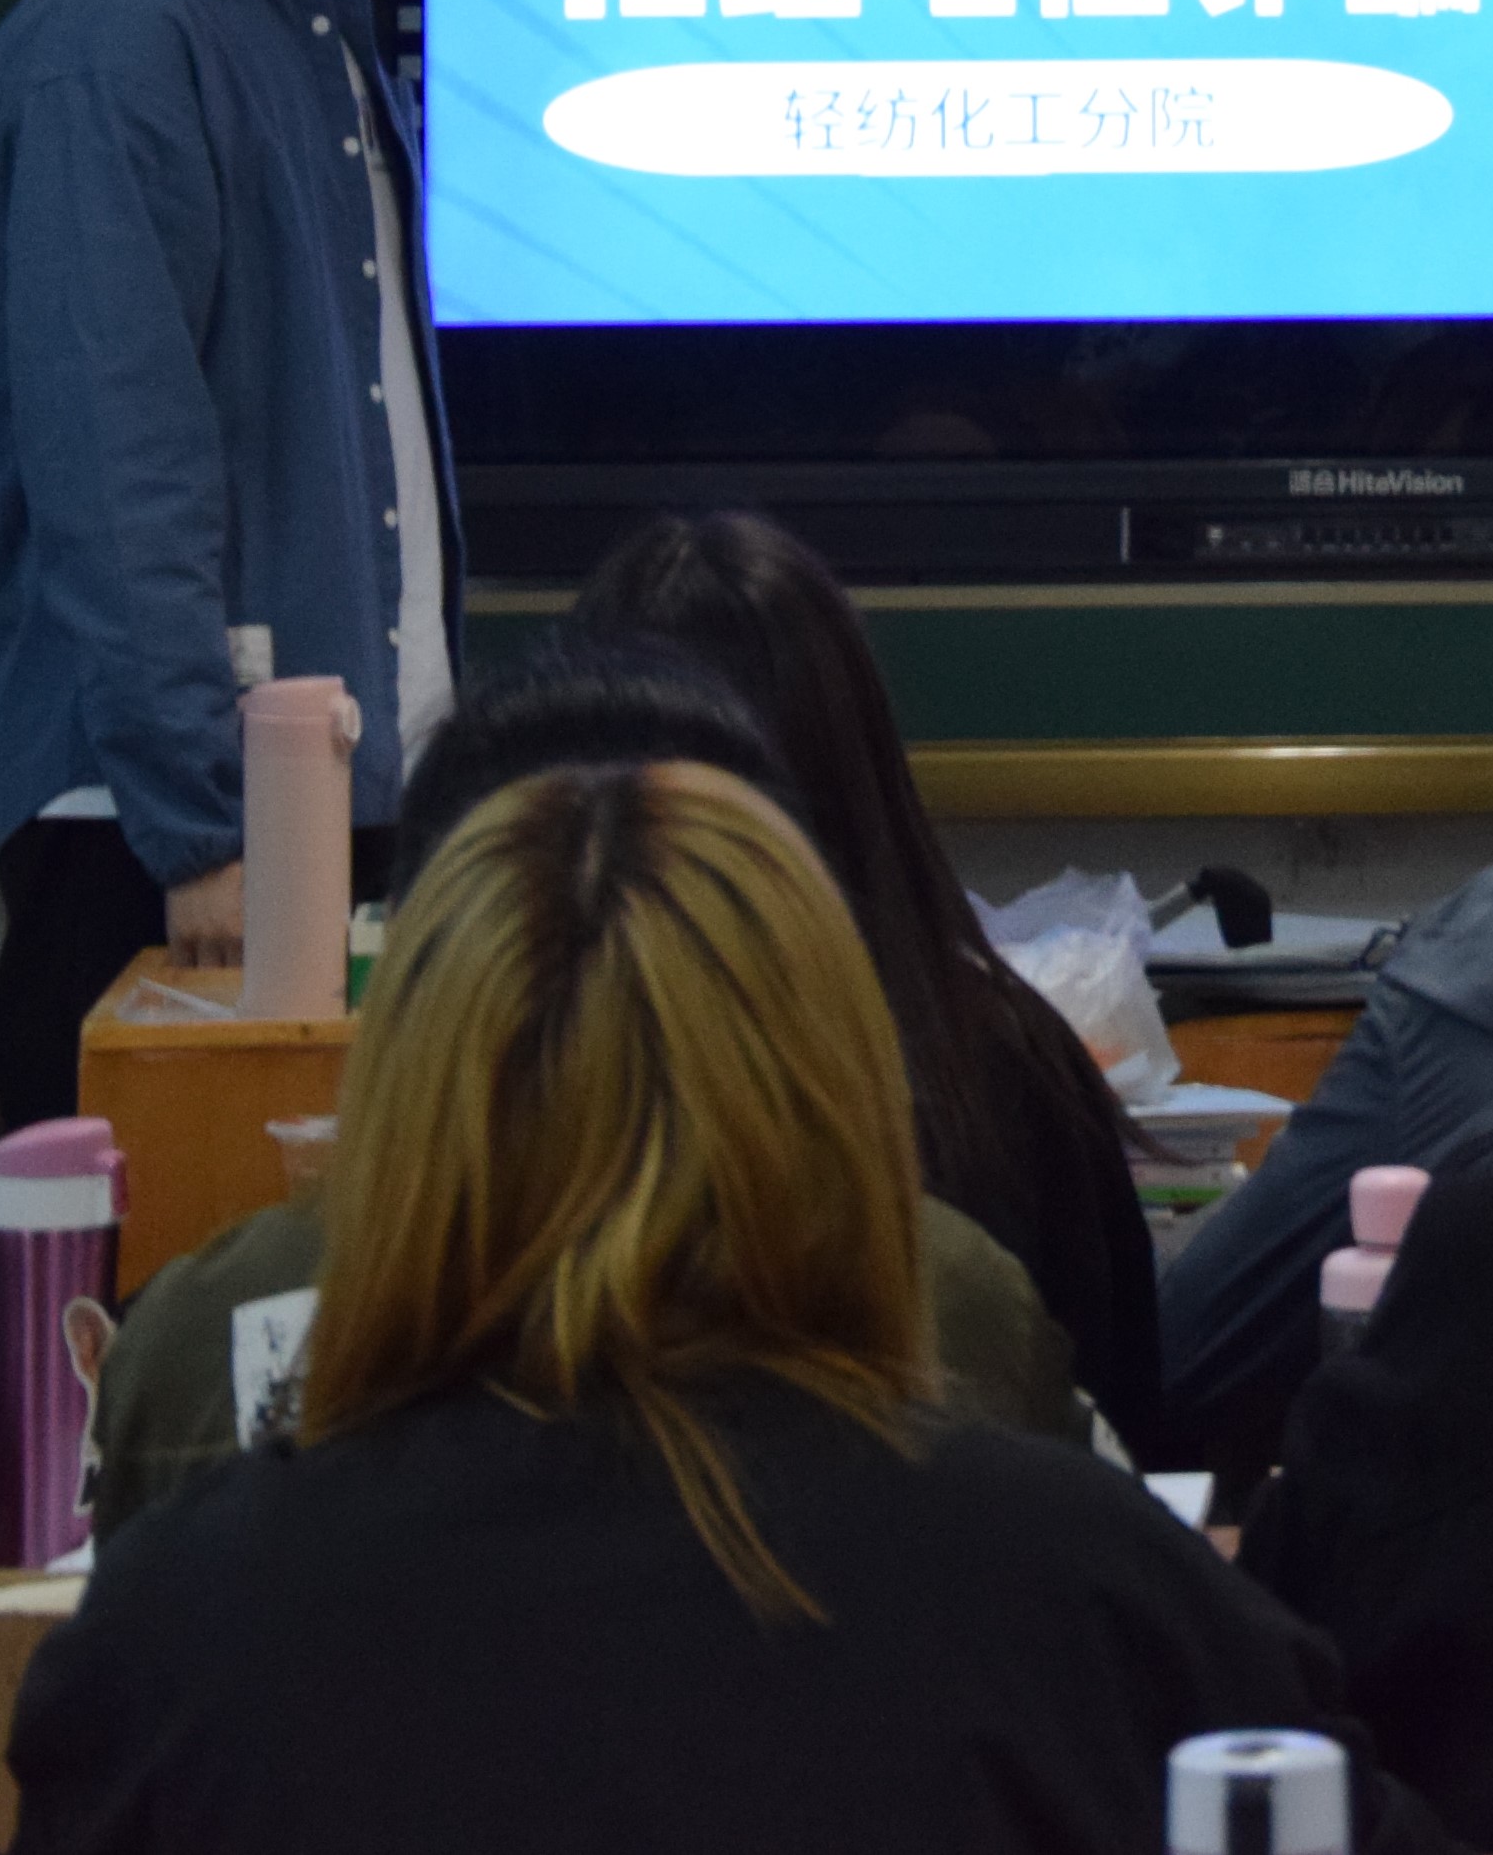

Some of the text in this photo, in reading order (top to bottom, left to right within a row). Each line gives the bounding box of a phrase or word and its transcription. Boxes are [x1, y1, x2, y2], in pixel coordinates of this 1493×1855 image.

[783, 86, 1216, 150] 轻纺化工分院
